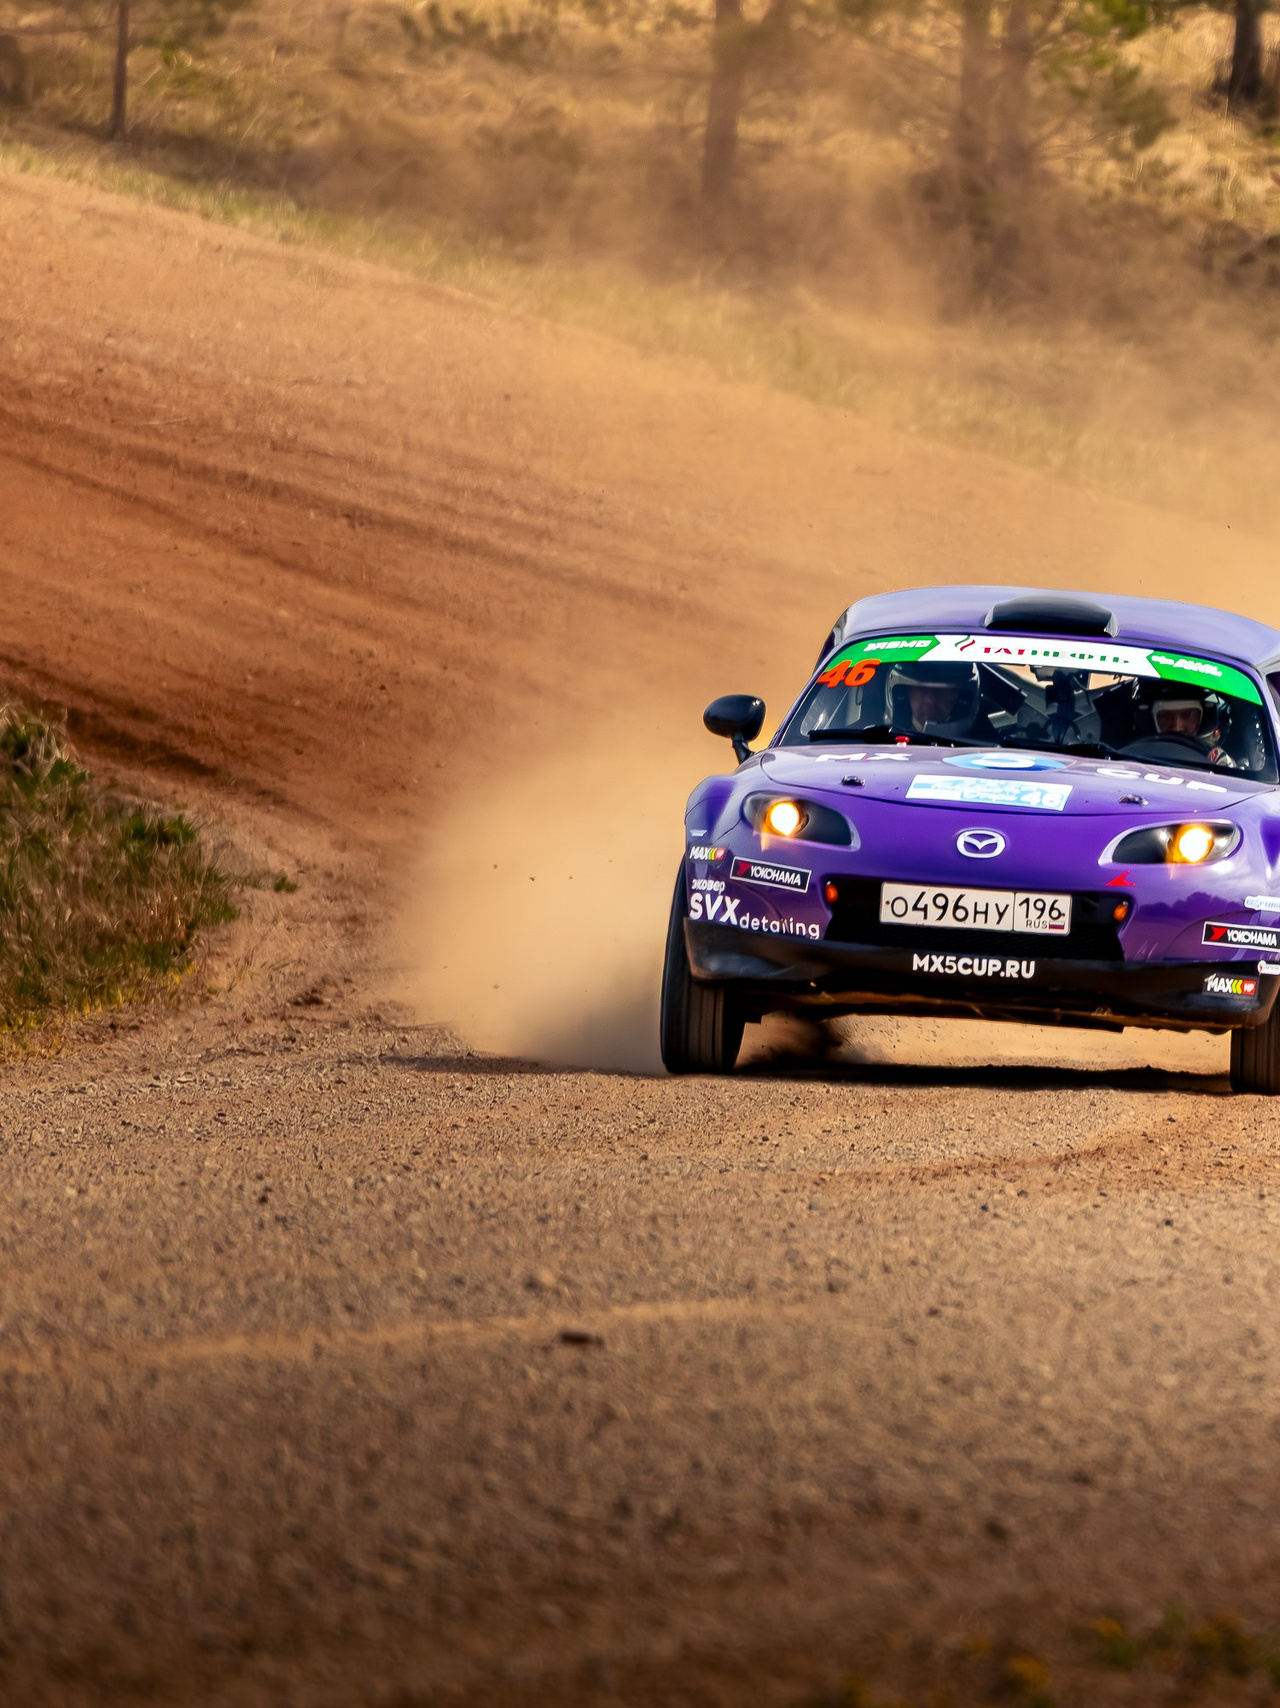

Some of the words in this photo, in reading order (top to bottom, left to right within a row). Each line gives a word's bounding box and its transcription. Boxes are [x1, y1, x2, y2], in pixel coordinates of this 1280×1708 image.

[817, 658, 881, 689] 46
[815, 752, 913, 763] MX
[1096, 767, 1228, 793] CUP
[1020, 790, 1062, 808] 46
[750, 865, 802, 887] YOKOHAMA
[689, 892, 741, 926] SVX
[1018, 897, 1062, 920] 196
[1025, 918, 1048, 930] RUS
[1226, 929, 1278, 947] YOKOHAMA
[912, 953, 1036, 979] MX5CUP.RU
